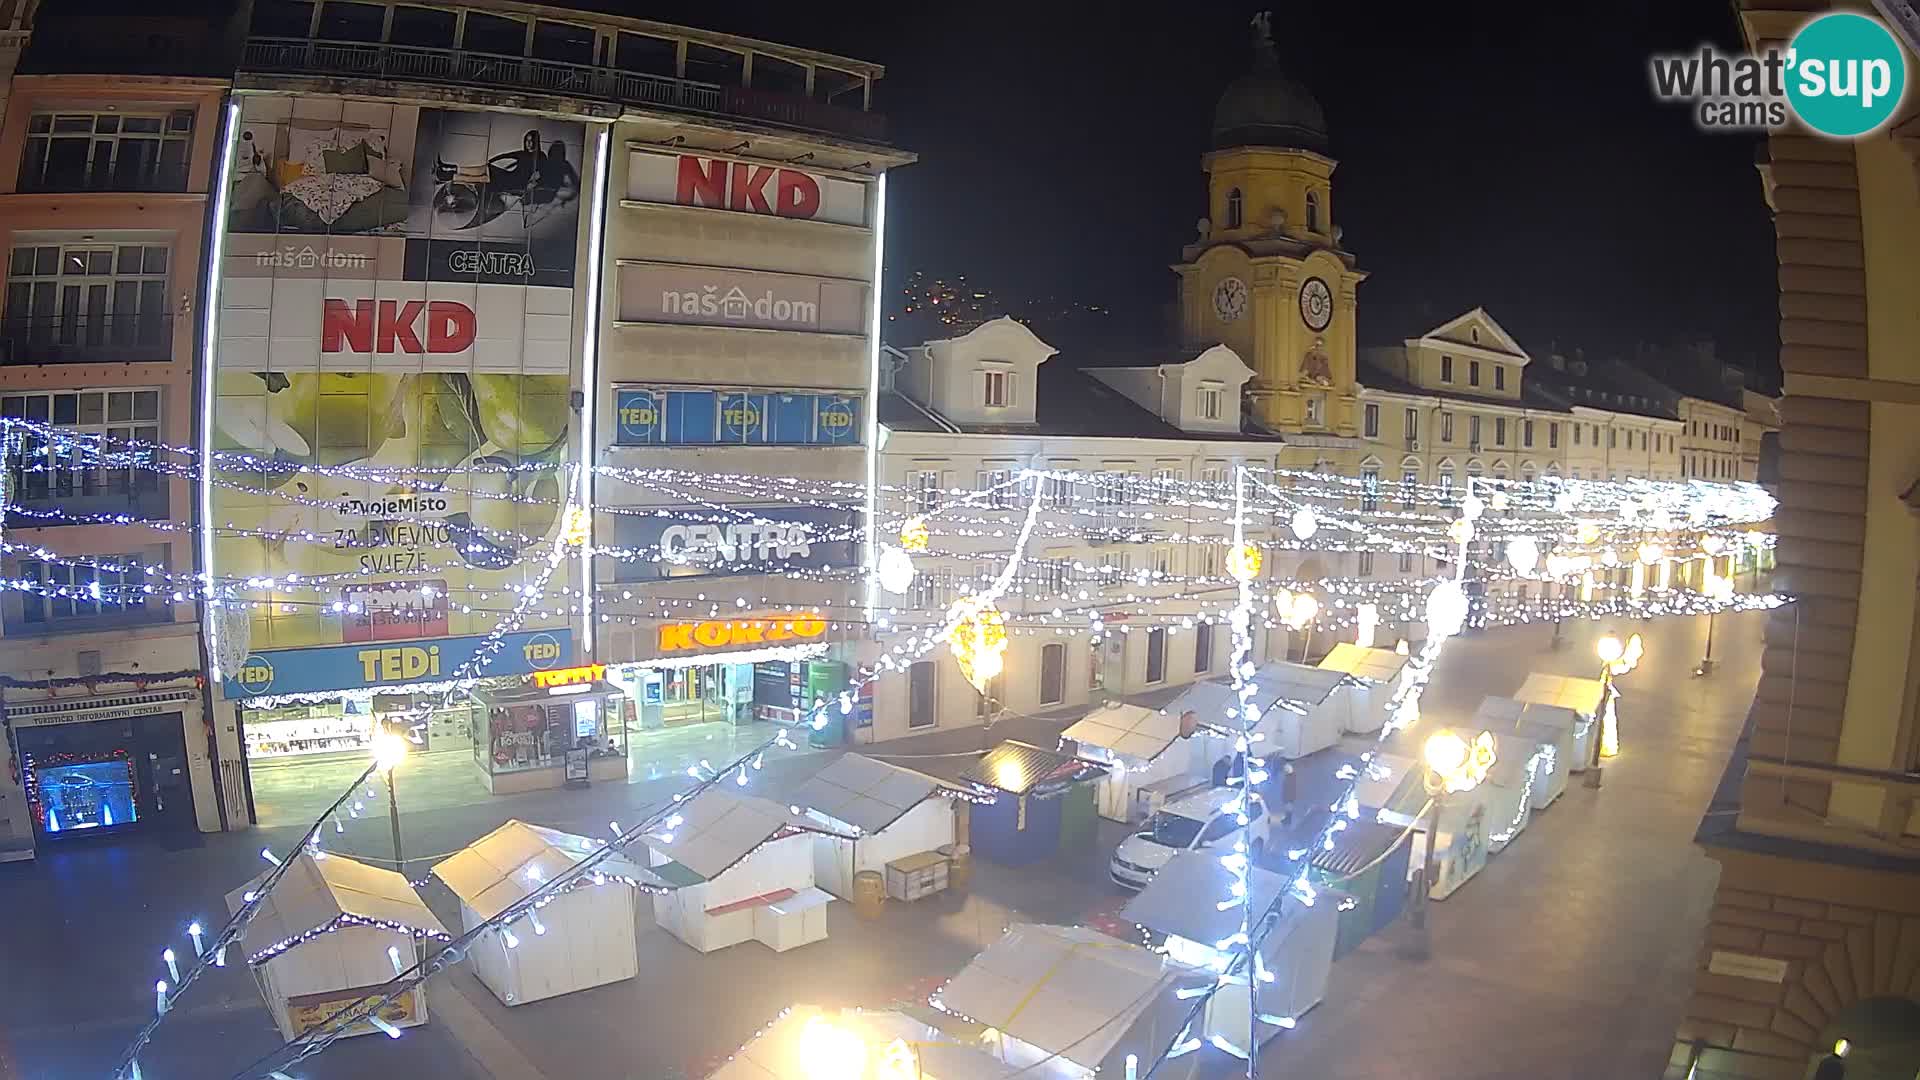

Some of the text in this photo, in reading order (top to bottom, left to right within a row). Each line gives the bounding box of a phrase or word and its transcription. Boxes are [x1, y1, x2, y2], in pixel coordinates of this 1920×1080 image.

[676, 154, 821, 219] NKD
[255, 246, 367, 270] naš dom
[448, 249, 536, 277] CENTRA
[661, 284, 817, 323] naš dom
[321, 298, 478, 354] NKD
[339, 497, 447, 516] #TvojeMisto
[334, 522, 451, 549] ZA DNEVNO
[659, 522, 811, 563] CENTRA
[657, 612, 827, 651] KORZO
[358, 645, 441, 683] TEDi
[522, 642, 561, 661] TEDi
[533, 663, 606, 688] TOMMY
